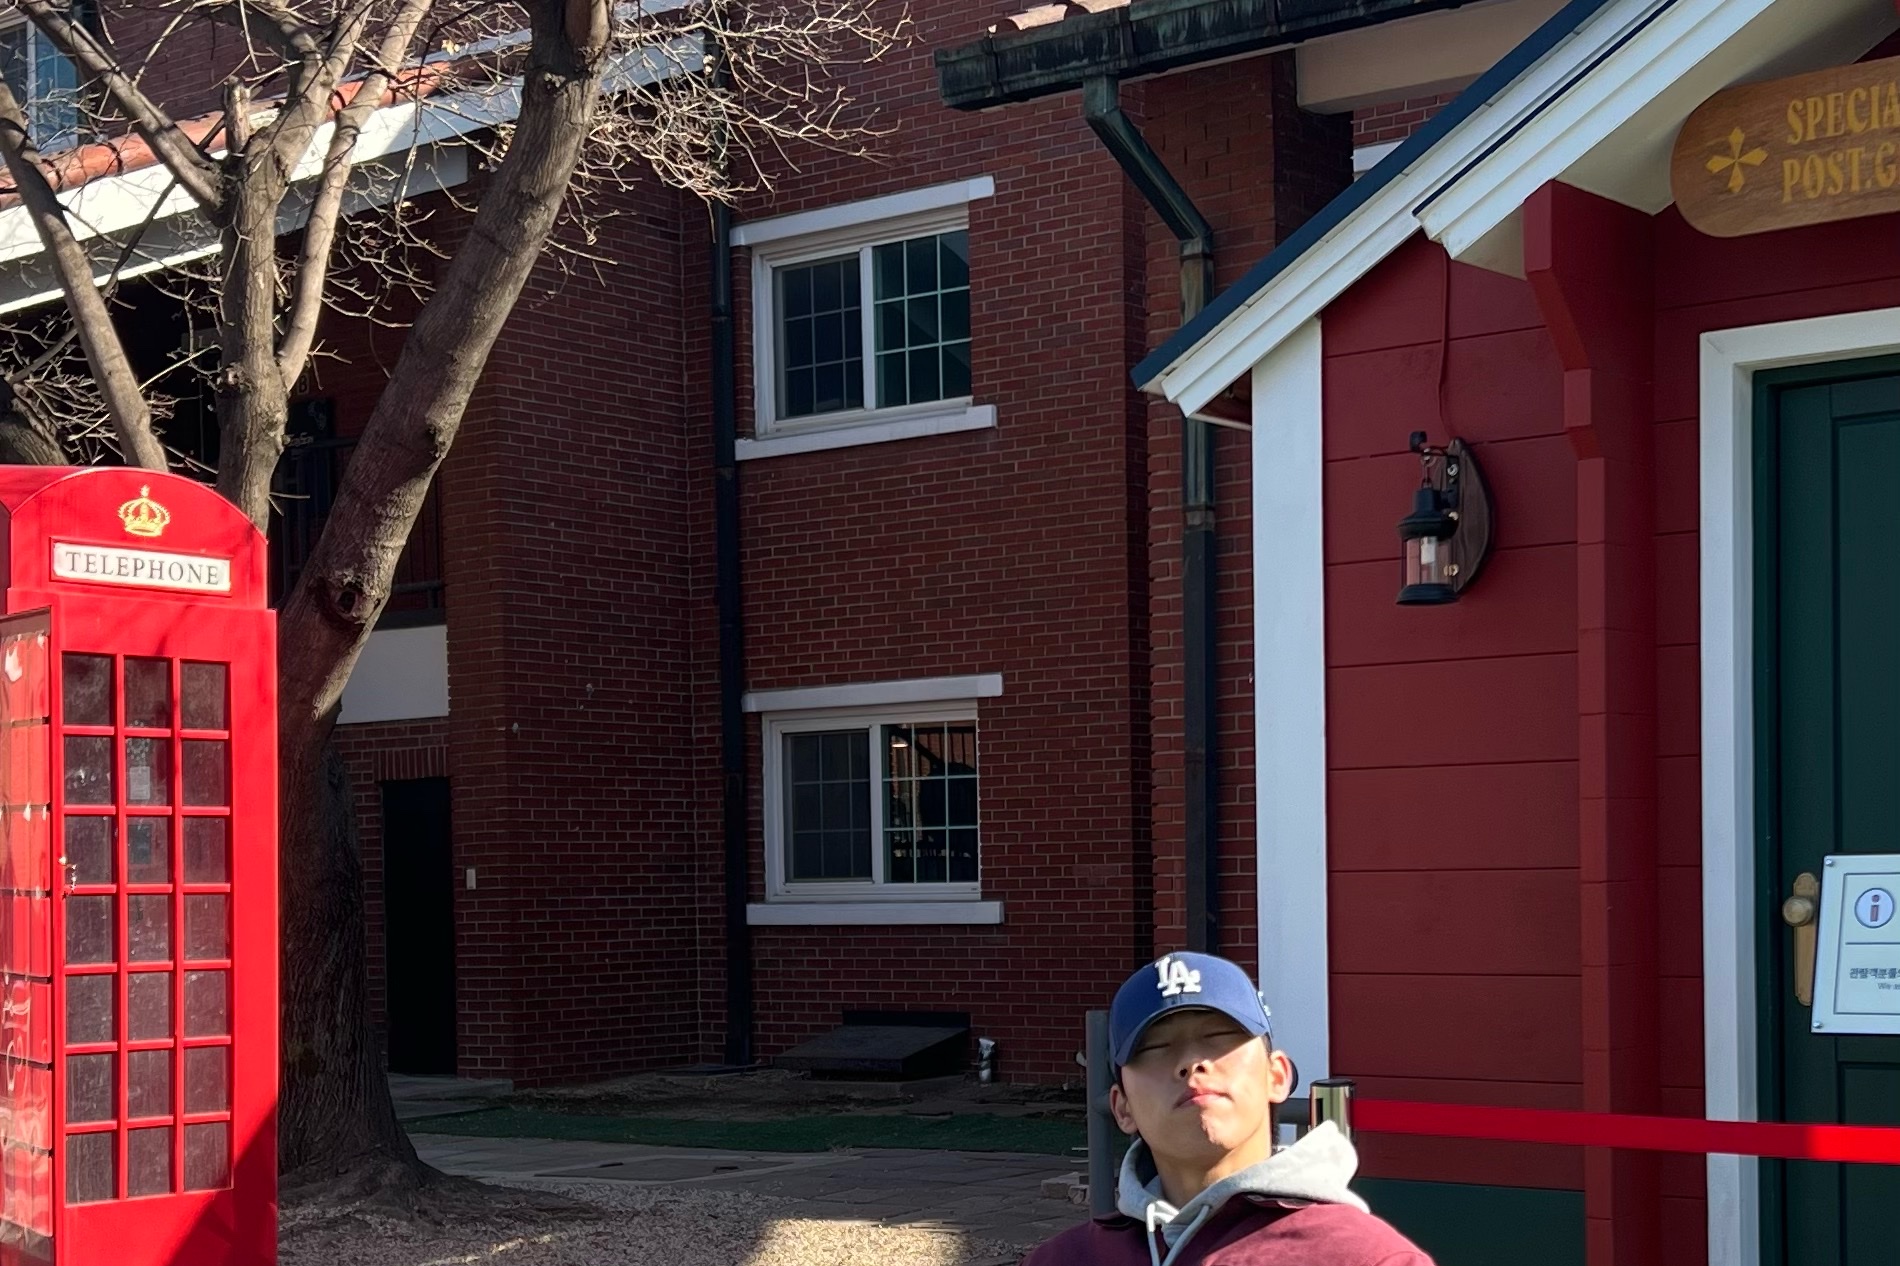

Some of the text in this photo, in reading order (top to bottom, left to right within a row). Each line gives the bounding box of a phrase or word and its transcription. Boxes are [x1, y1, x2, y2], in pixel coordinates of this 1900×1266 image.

[1786, 82, 1900, 145] SPECIA
[1782, 141, 1900, 203] POST.G
[65, 551, 220, 585] TELEPHONE
[1155, 956, 1202, 997] LA
